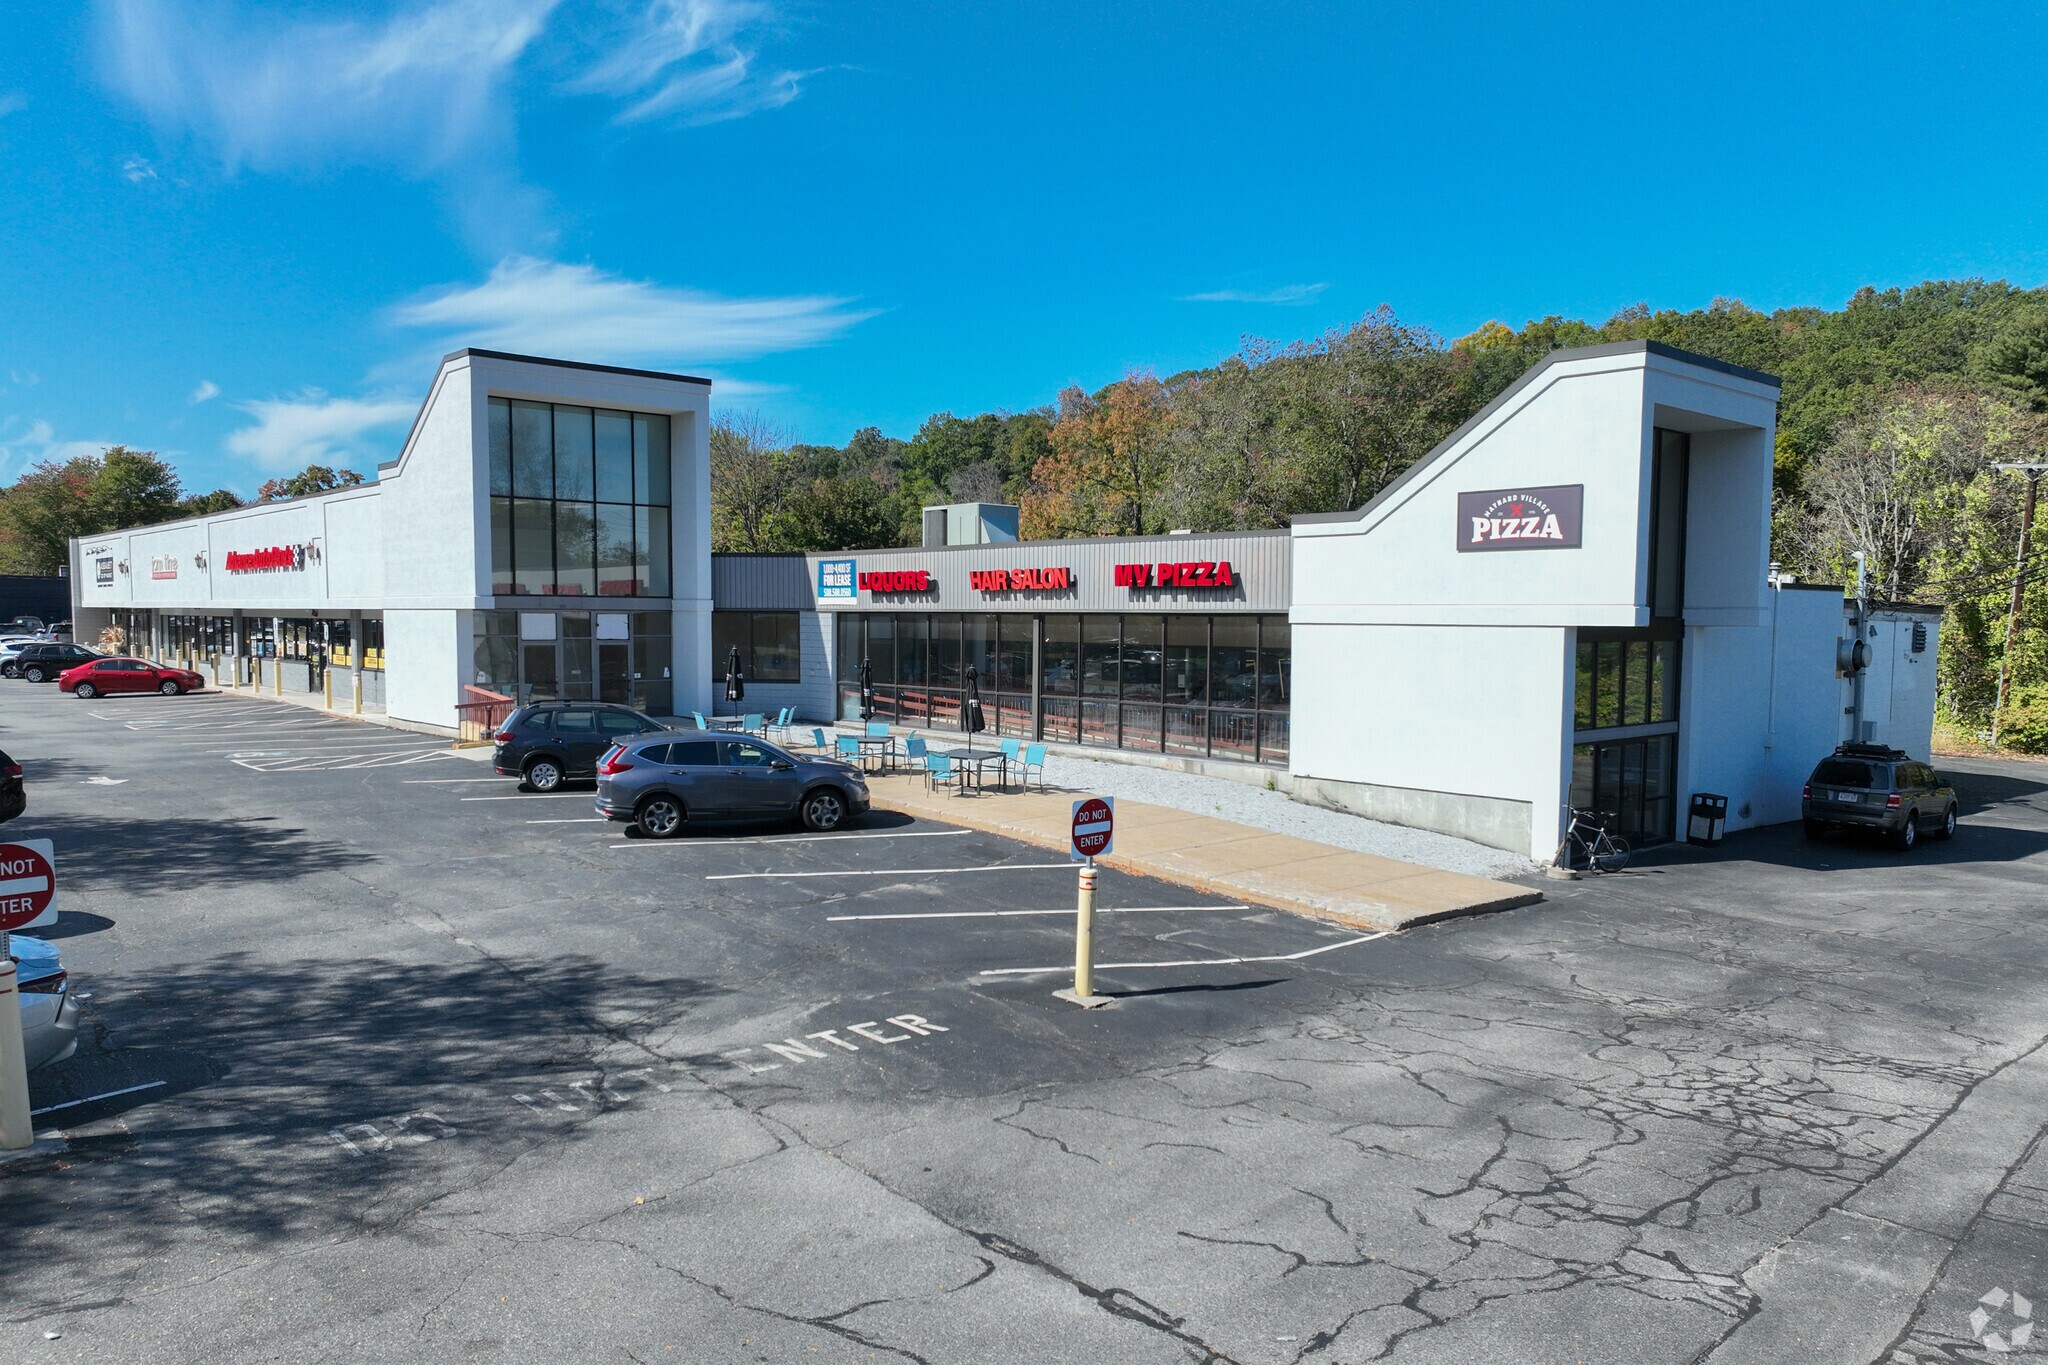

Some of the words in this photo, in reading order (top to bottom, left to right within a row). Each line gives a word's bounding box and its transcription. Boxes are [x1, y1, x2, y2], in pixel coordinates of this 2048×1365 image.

[1484, 495, 1517, 517] MAYNARD
[1521, 494, 1551, 514] VILLAGE
[1471, 514, 1563, 543] PIZZA
[823, 574, 834, 586] FOR
[834, 574, 852, 586] LEASE
[859, 570, 928, 592] LIQUORS
[970, 570, 1007, 590] HAIR
[1011, 567, 1068, 589] SALON
[1115, 564, 1151, 586] MV
[1157, 562, 1232, 586] PIZZA
[1079, 811, 1090, 822] DO
[1092, 809, 1107, 820] NOT
[1080, 834, 1104, 847] ENTER
[0, 859, 36, 876] NOT
[0, 898, 33, 914] TER
